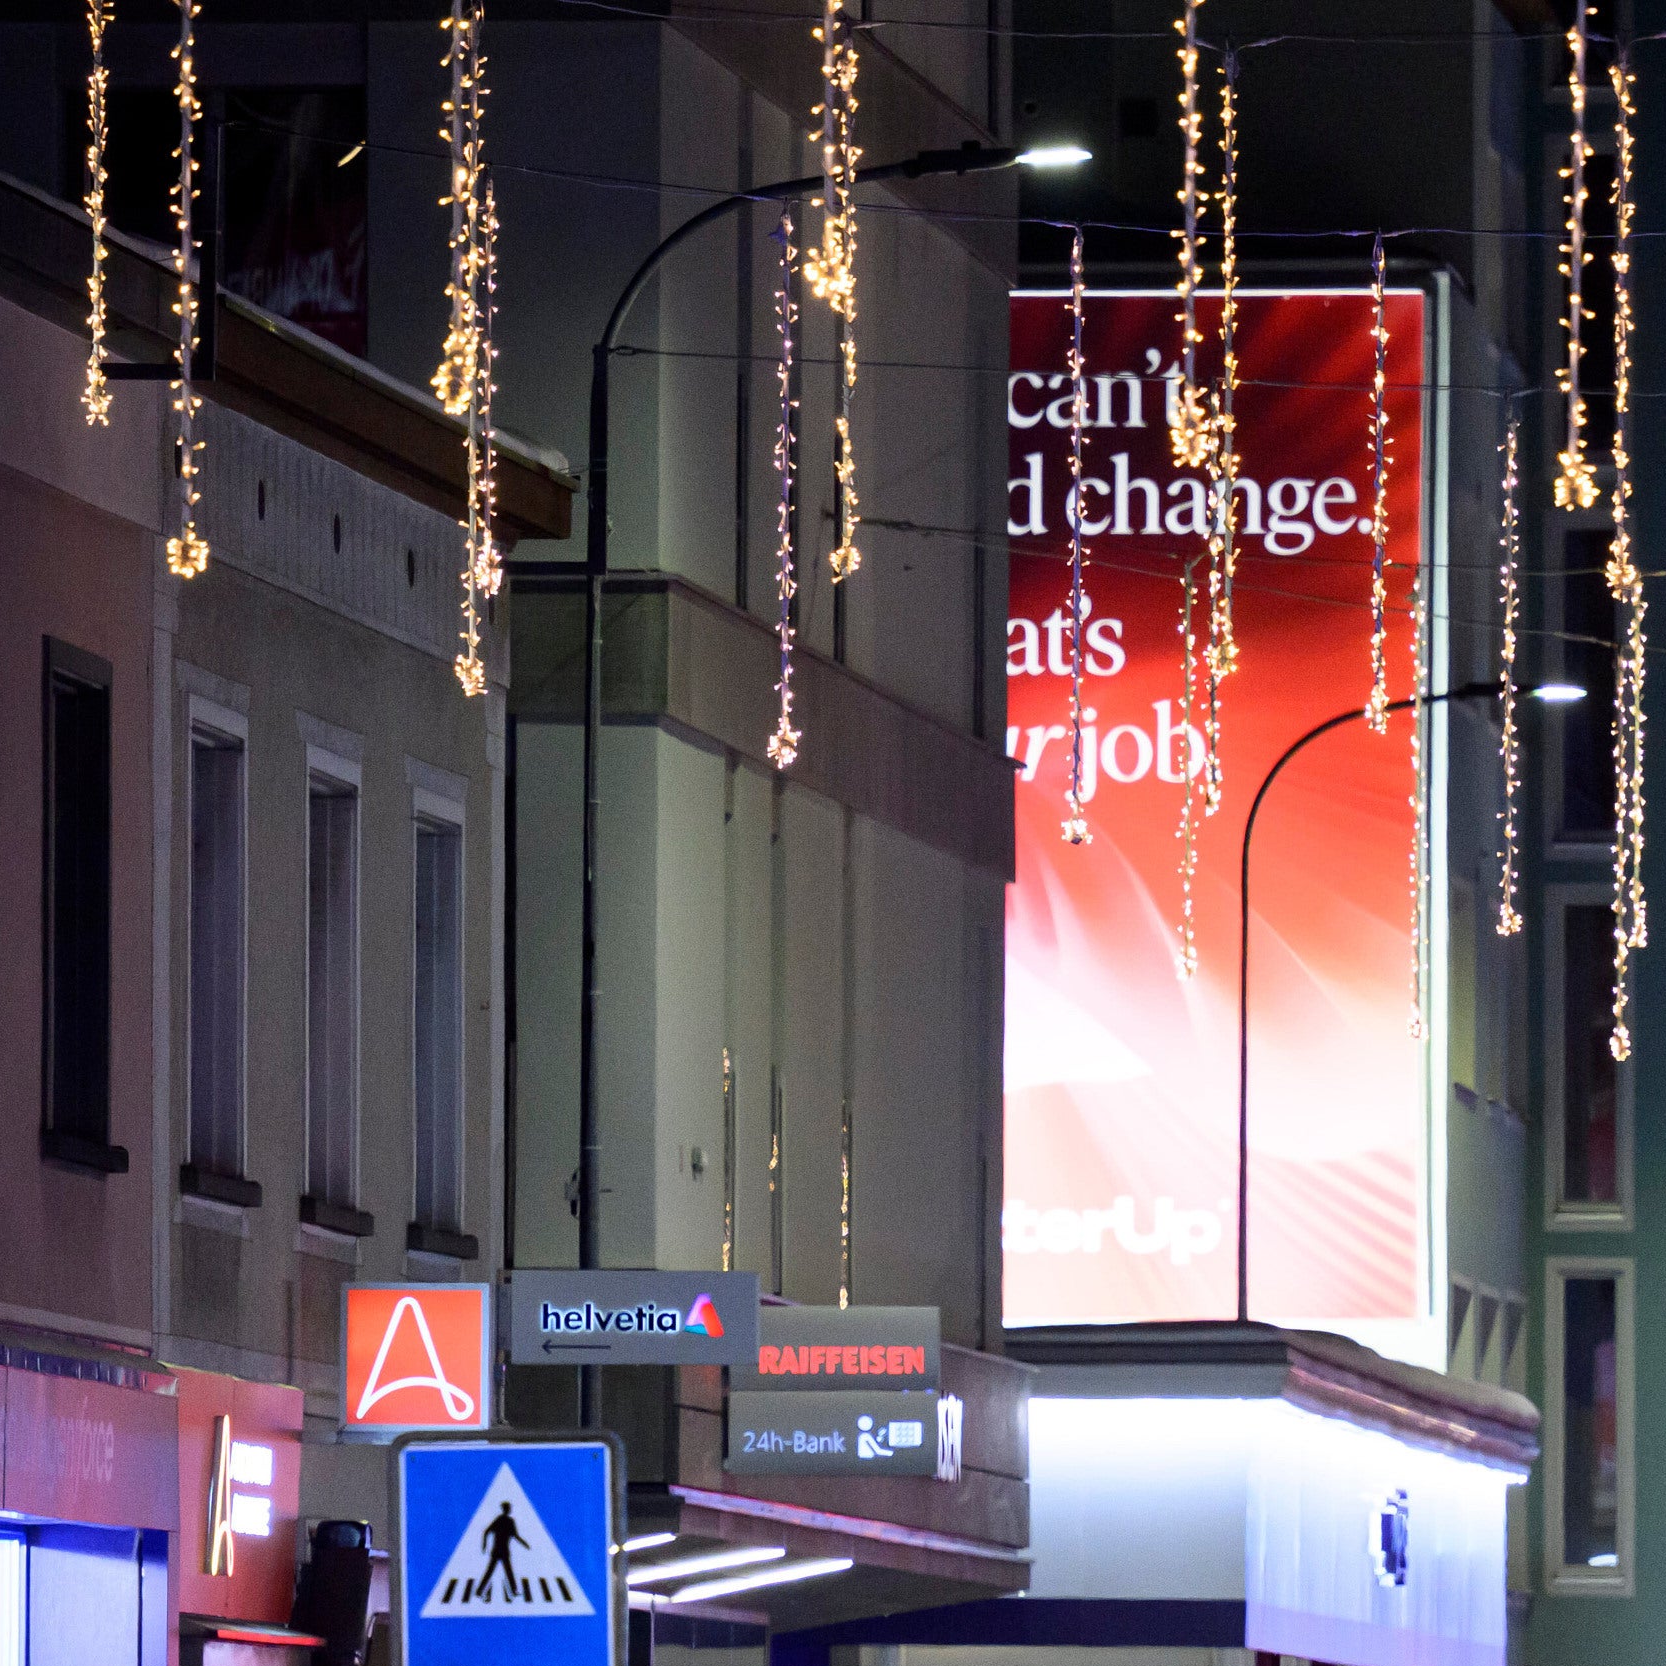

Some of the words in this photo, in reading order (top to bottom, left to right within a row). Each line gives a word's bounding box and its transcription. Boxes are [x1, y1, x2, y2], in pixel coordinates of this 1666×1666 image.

[1065, 452, 1375, 557] change.
[1002, 1195, 1223, 1266] terUp
[541, 1302, 678, 1333] helvetia
[758, 1345, 925, 1375] RAIFFEISEN
[742, 1430, 847, 1454] 24h-Bank
